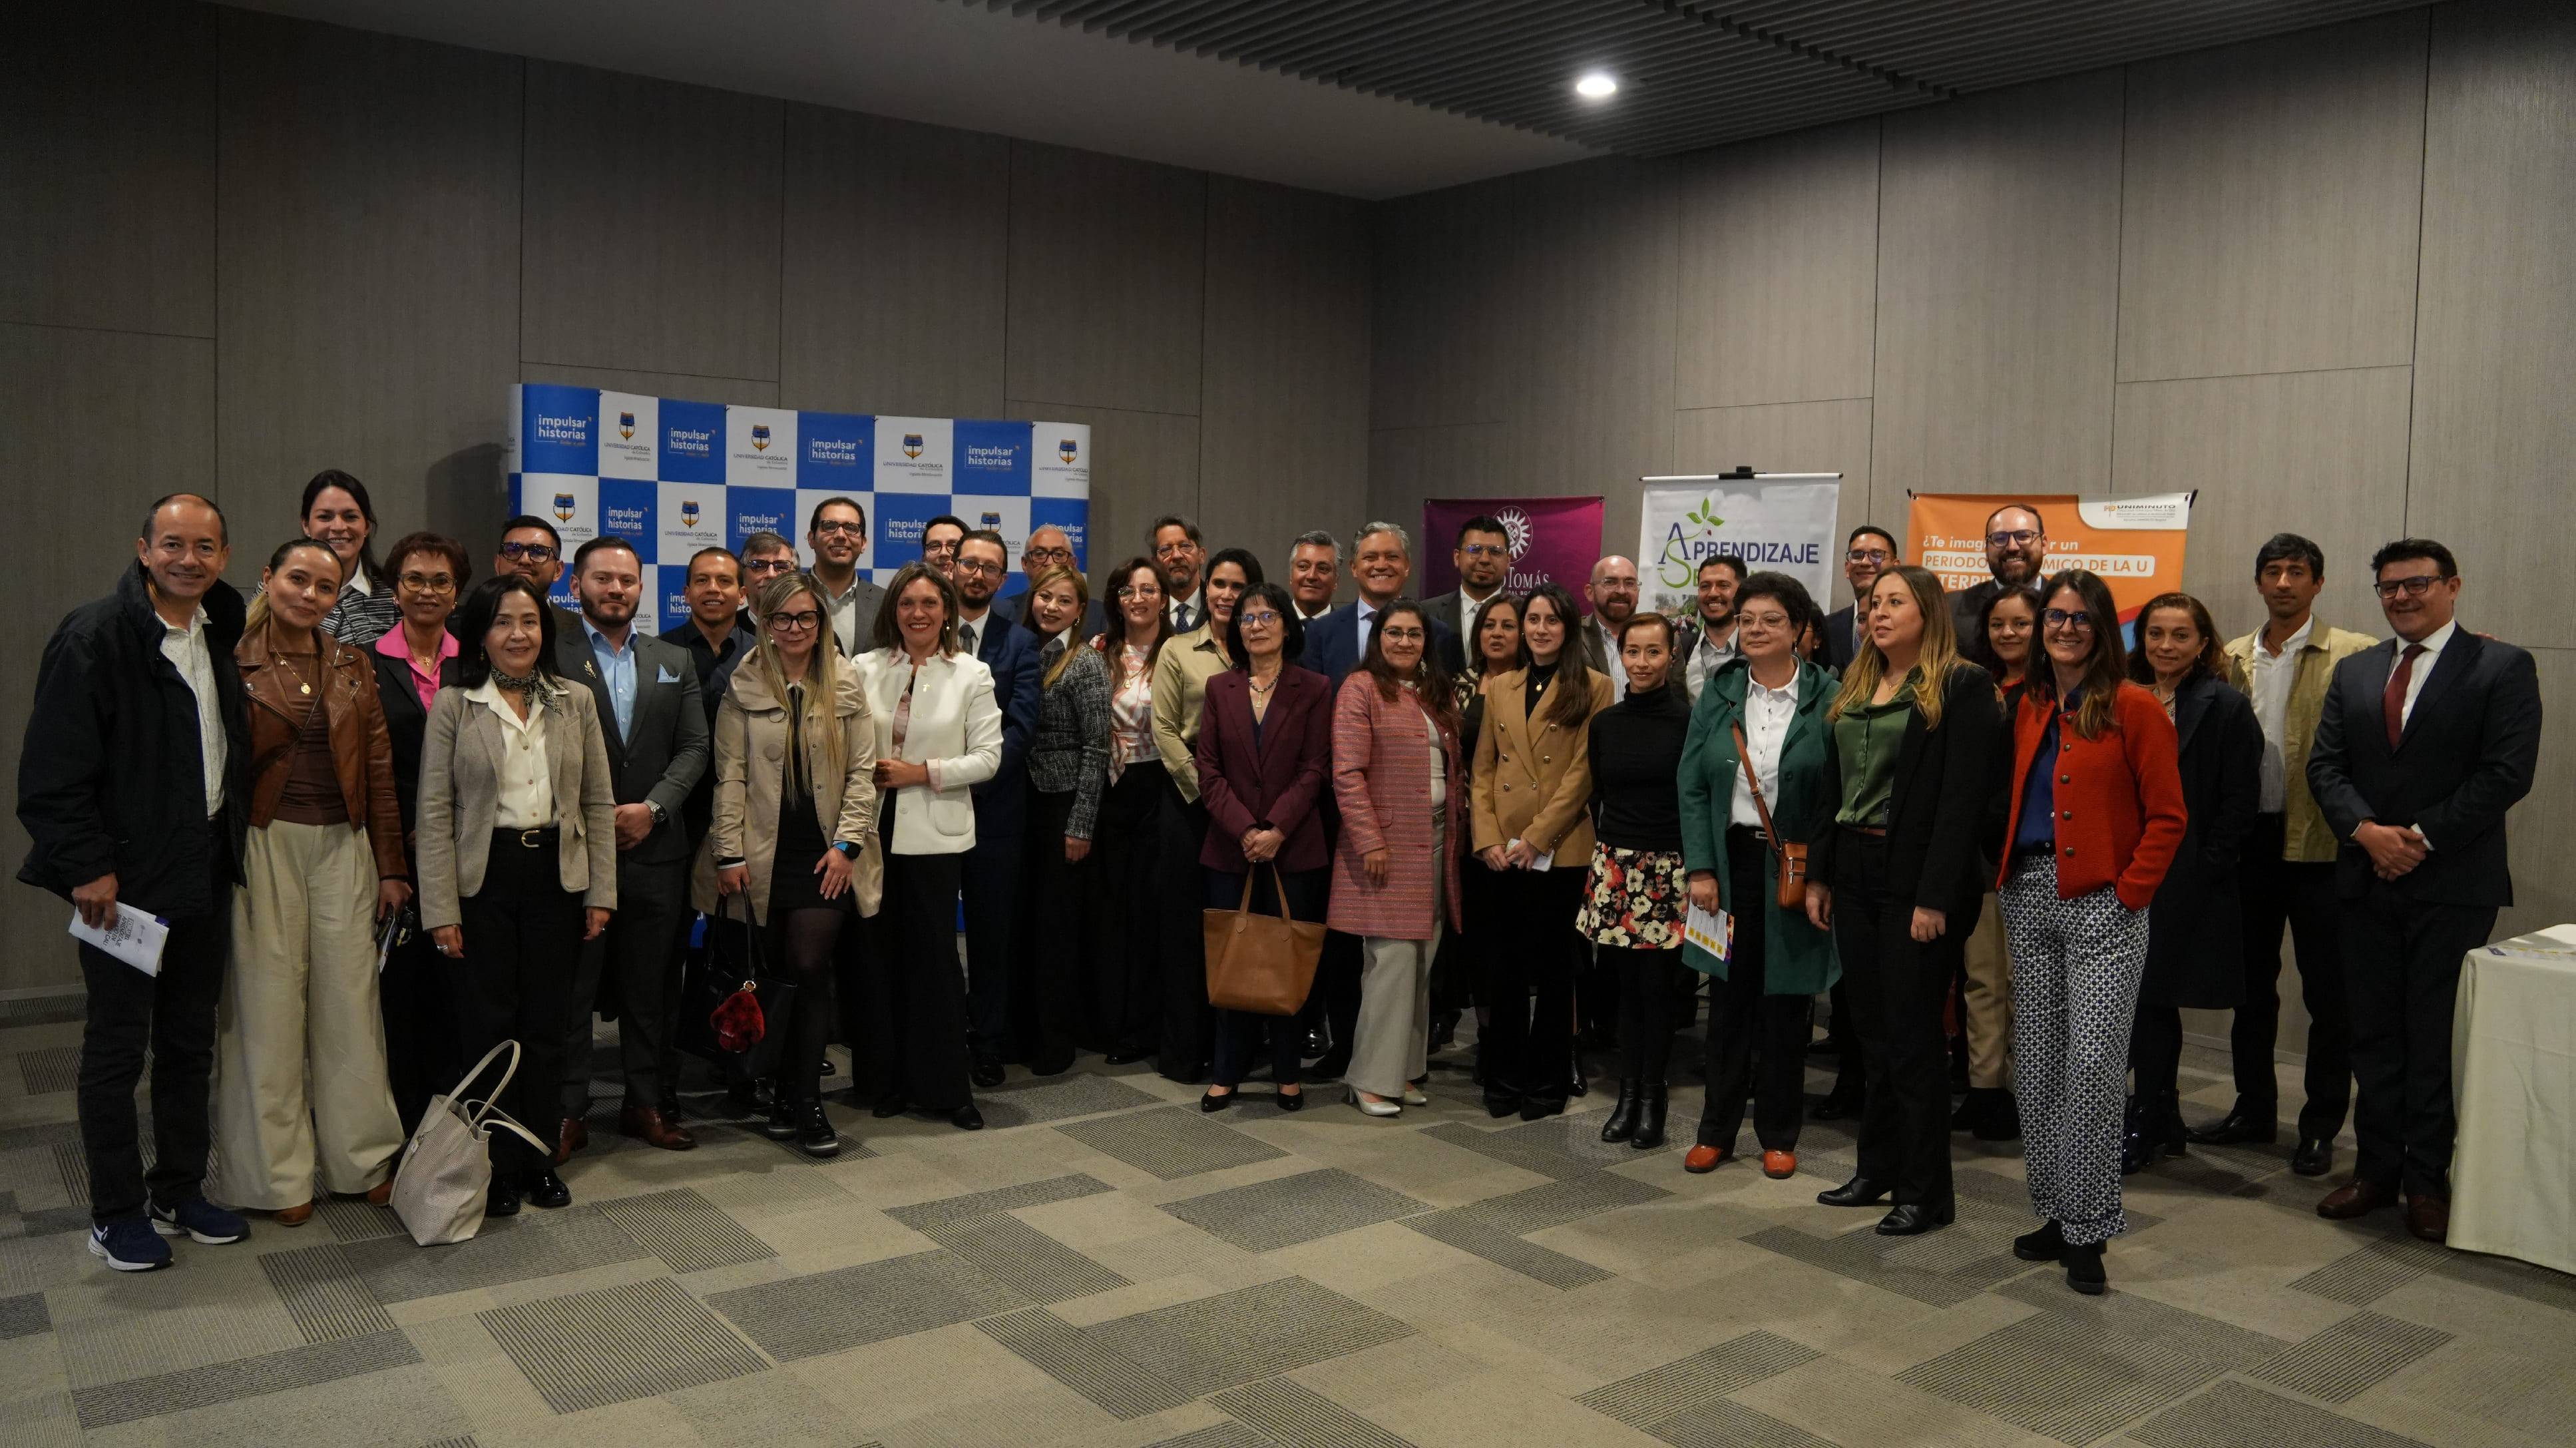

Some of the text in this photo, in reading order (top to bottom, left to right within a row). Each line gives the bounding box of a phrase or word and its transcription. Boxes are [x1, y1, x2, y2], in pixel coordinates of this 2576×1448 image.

[538, 414, 586, 428] impulsar
[538, 426, 586, 440] historias
[670, 427, 710, 441] impulsar
[670, 439, 709, 451] historias
[812, 438, 856, 451] impulsar
[812, 449, 855, 460] historias
[968, 445, 1013, 457] impulsar
[968, 456, 1012, 465] historias
[608, 507, 642, 519] impulsar
[739, 513, 777, 525] impulsar
[608, 518, 642, 530] historias
[740, 523, 777, 533] historias
[889, 519, 927, 529] impulsa
[889, 529, 923, 538] histori
[1658, 522, 1819, 565] APRENDIZAJE
[1924, 535, 1945, 547] ¿Te
[1950, 536, 1986, 551] imag
[2060, 541, 2078, 550] un
[1926, 555, 2147, 572] PERIODO MICO DE LA U
[670, 603, 692, 612] histo
